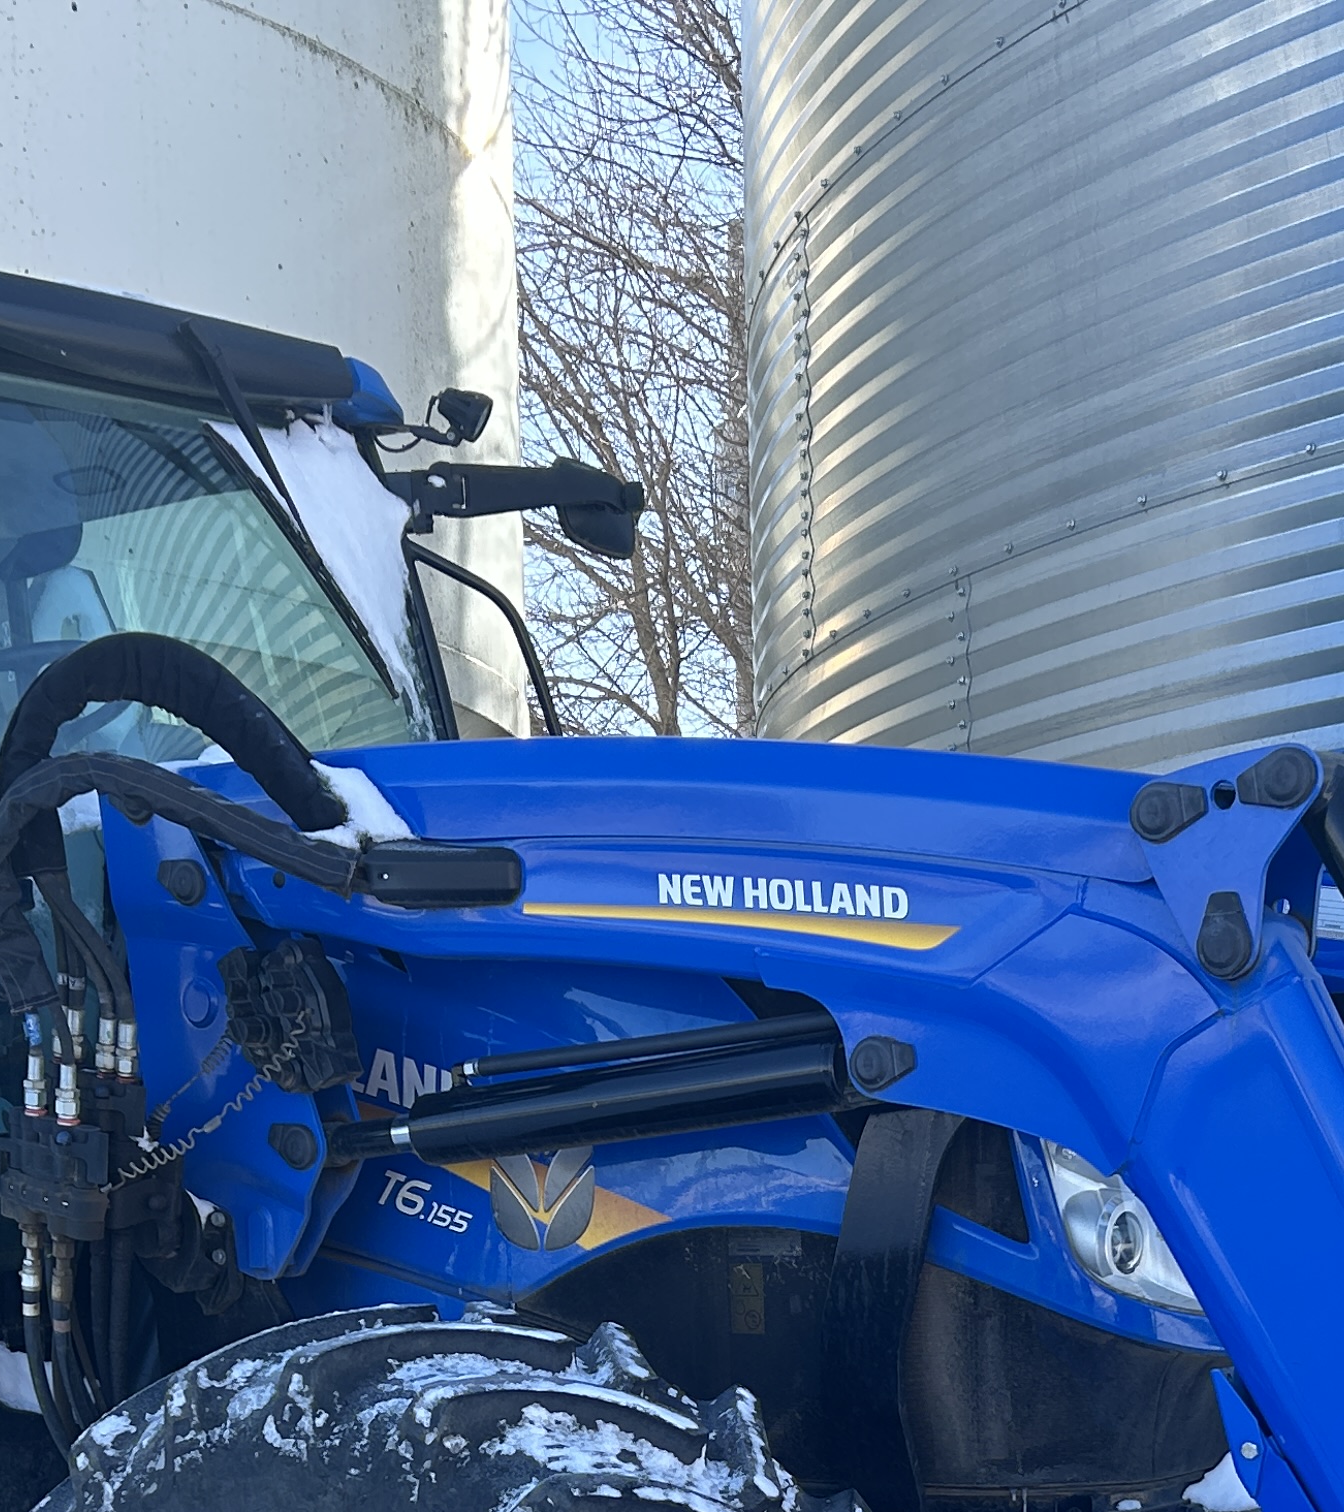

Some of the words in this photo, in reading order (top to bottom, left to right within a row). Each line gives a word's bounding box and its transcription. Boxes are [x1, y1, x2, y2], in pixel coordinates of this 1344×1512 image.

[658, 874, 734, 908] NEW
[743, 877, 909, 919] HOLLAND
[377, 1169, 474, 1233] T6.155
